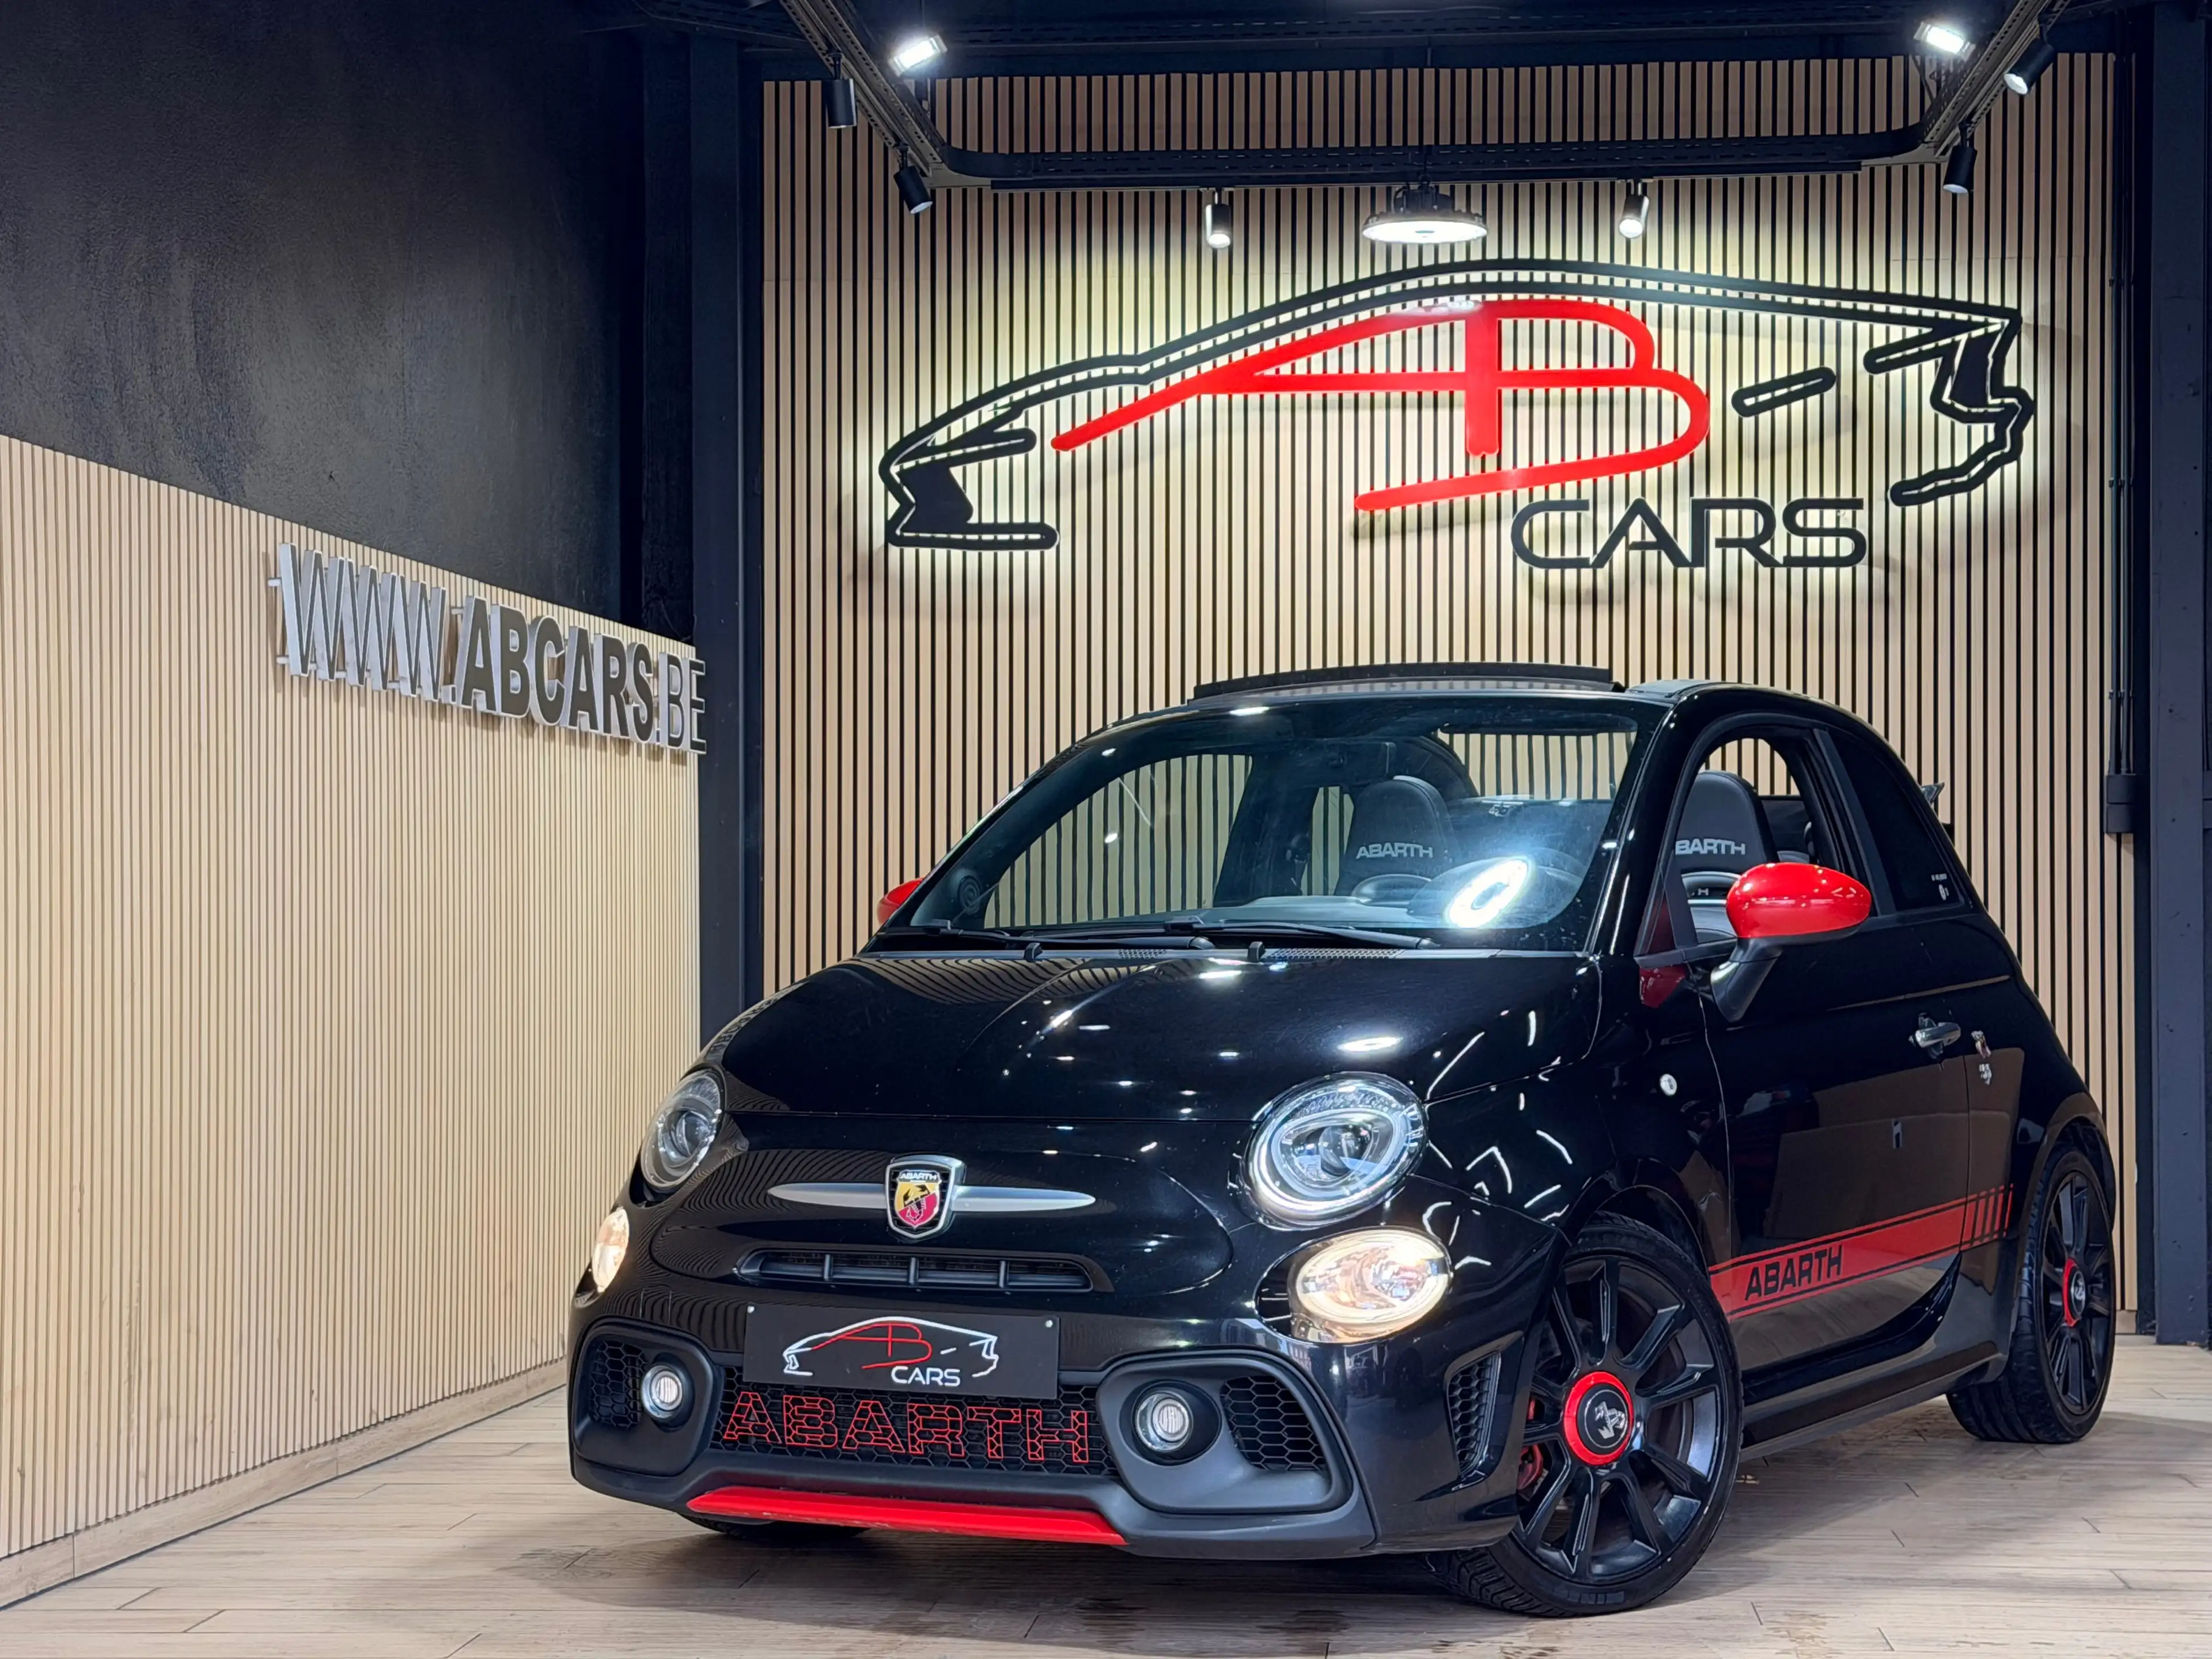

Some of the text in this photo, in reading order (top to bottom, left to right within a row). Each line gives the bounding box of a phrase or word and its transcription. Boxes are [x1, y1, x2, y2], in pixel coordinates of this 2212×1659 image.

[1512, 498, 1867, 569] CARS
[279, 543, 706, 755] WWW.ABCARS.BE
[1356, 842, 1433, 859] ABARTH
[1675, 839, 1745, 855] BARTH
[900, 1172, 937, 1180] ABARTH
[1744, 1244, 1843, 1301] ABARTH
[891, 1366, 961, 1386] CARS
[723, 1391, 1089, 1463] ABARTH
